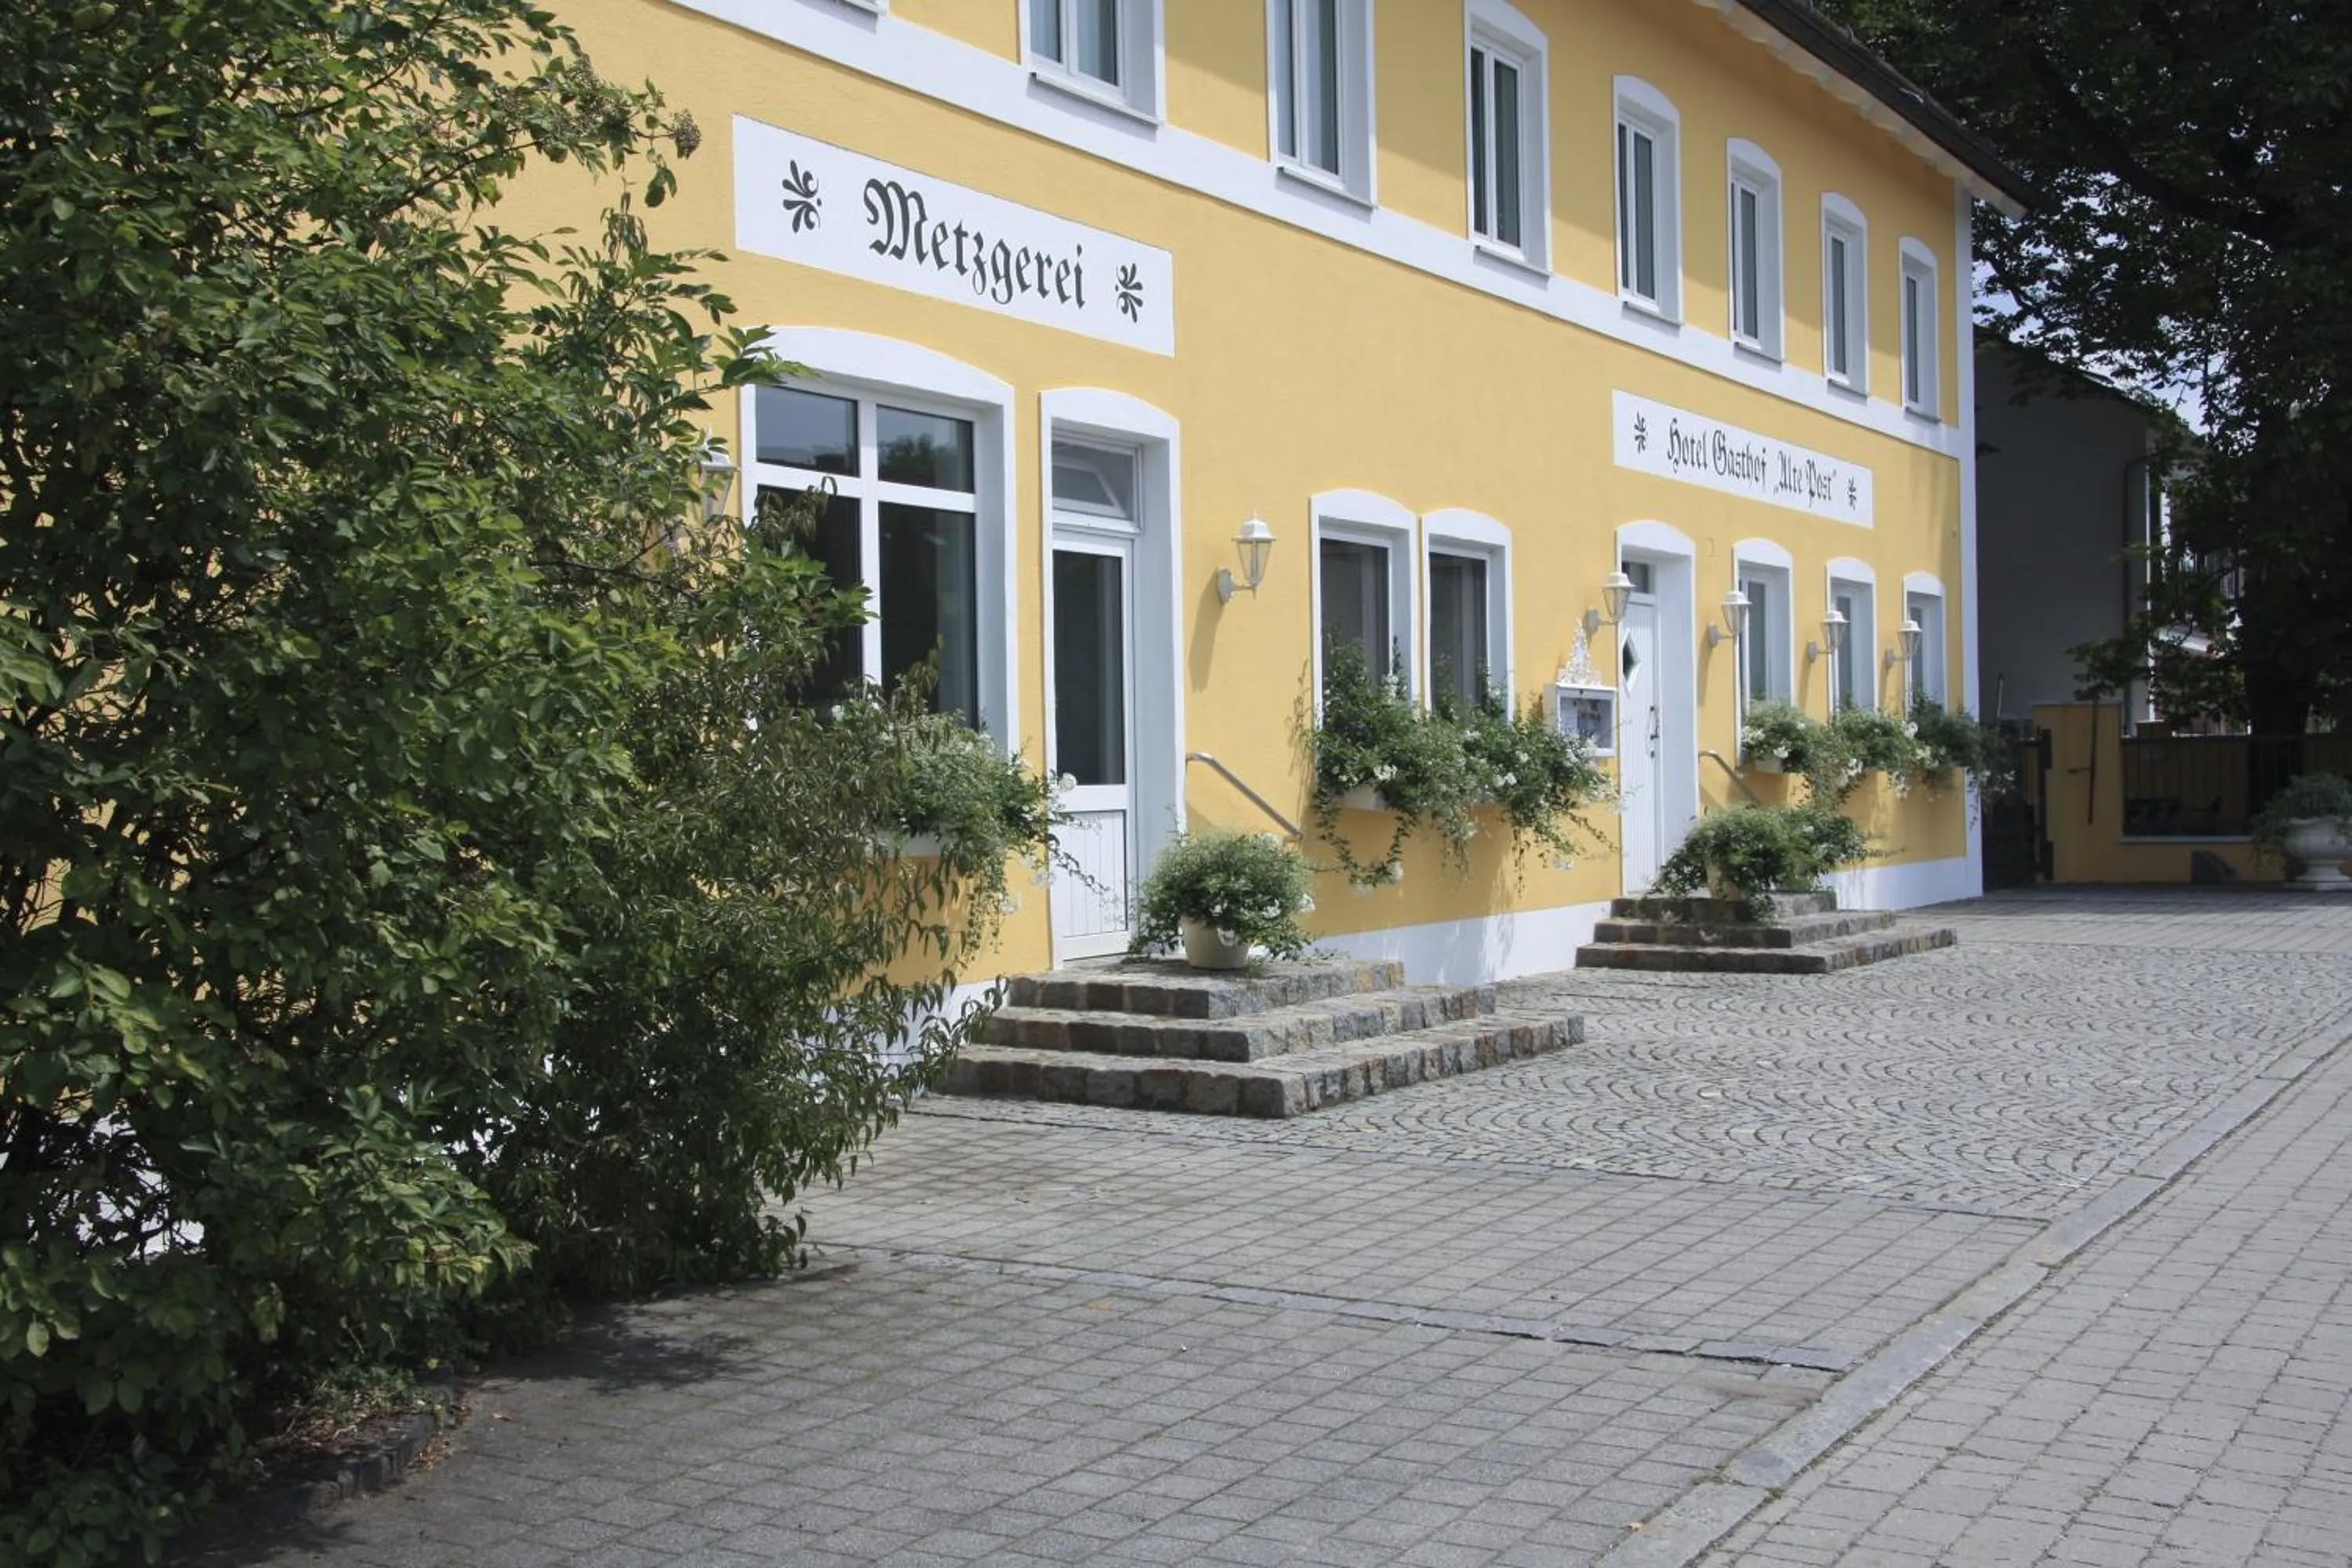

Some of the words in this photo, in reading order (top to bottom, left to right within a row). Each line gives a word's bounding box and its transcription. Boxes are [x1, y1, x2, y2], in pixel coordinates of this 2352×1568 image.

[863, 177, 1086, 310] Metzgerei
[1667, 417, 1708, 474] Hotel
[1712, 429, 1767, 492] Gasthof
